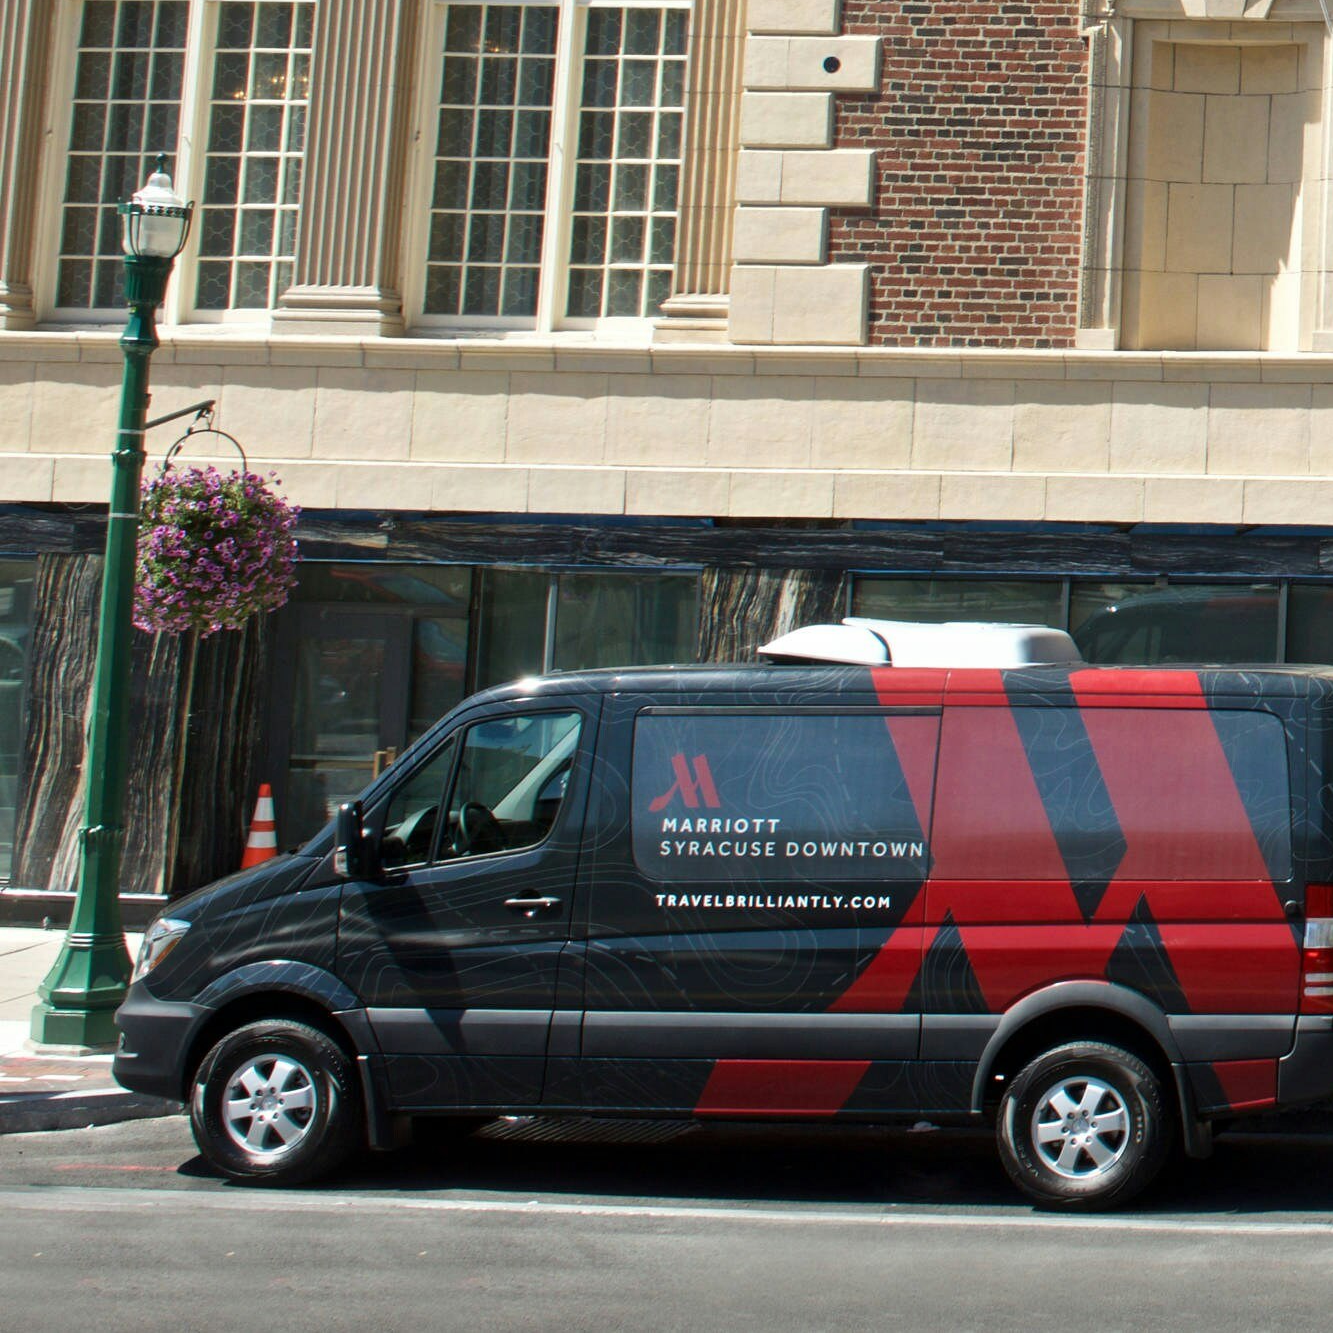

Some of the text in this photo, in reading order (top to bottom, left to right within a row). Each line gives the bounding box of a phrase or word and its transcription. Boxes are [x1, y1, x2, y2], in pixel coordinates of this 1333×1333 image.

[661, 817, 781, 834] MARRIOTT
[659, 840, 924, 858] SYRACUSE DOWNTOWN
[655, 894, 891, 909] TRAVELBRILLIANTLY.COM
